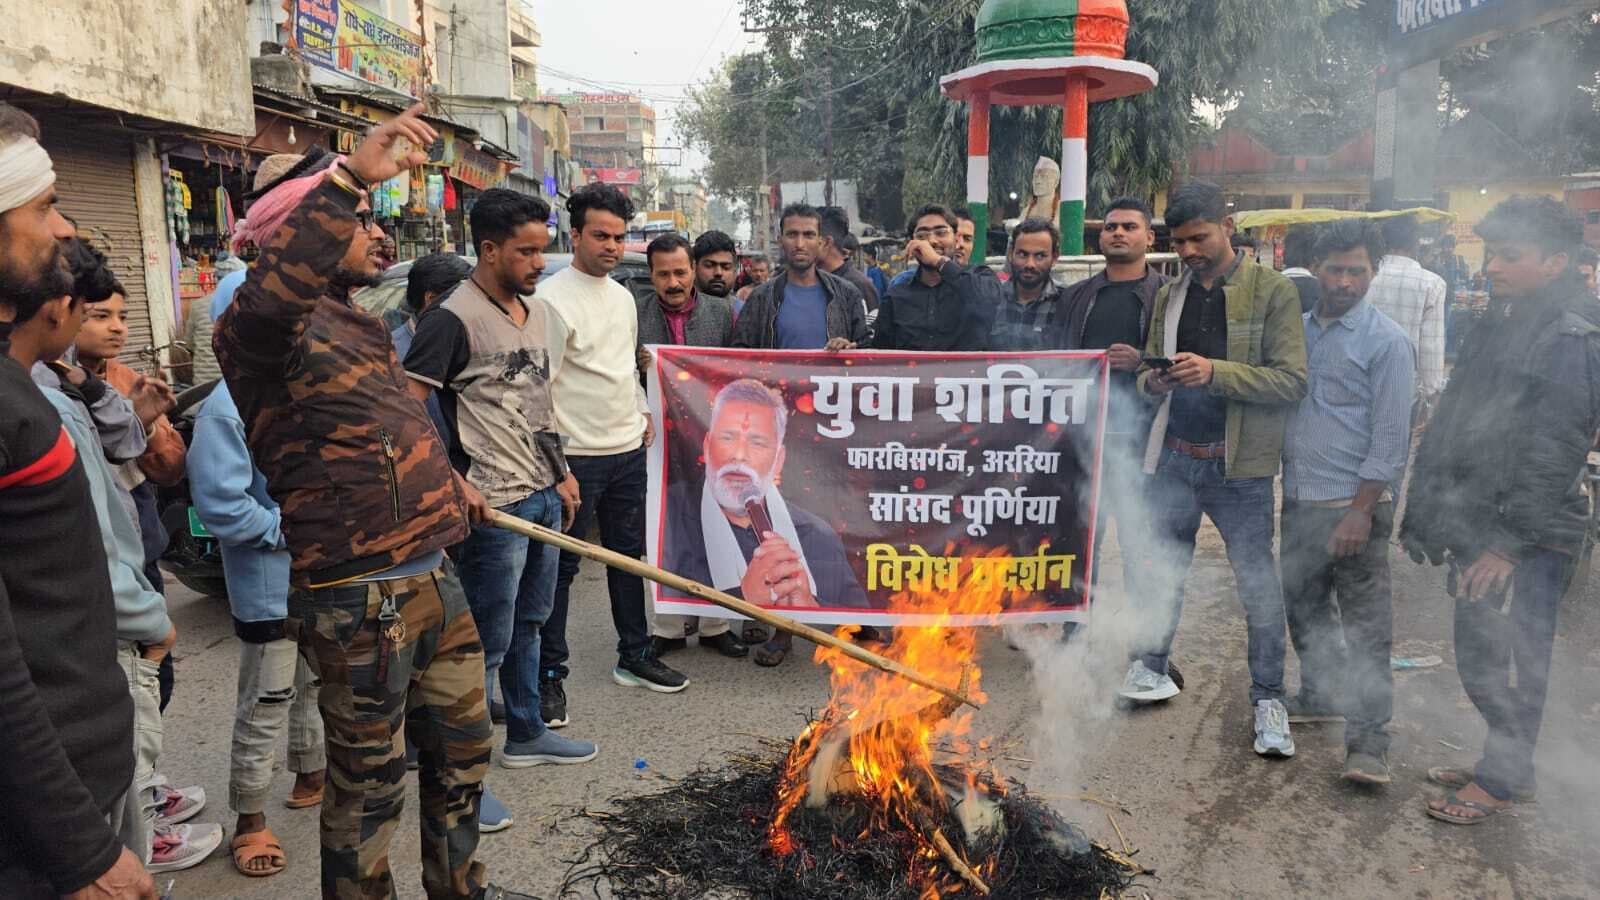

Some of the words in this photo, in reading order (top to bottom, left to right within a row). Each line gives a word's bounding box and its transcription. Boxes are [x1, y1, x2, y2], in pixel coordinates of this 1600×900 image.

[809, 374, 920, 439] युवा
[934, 364, 1095, 425] शक्ति
[847, 441, 974, 476] फारबिसगंज,
[982, 444, 1060, 474] अररिया
[868, 486, 954, 525] सांसद
[962, 487, 1060, 537] पूर्णिया
[866, 543, 961, 593] विरोध
